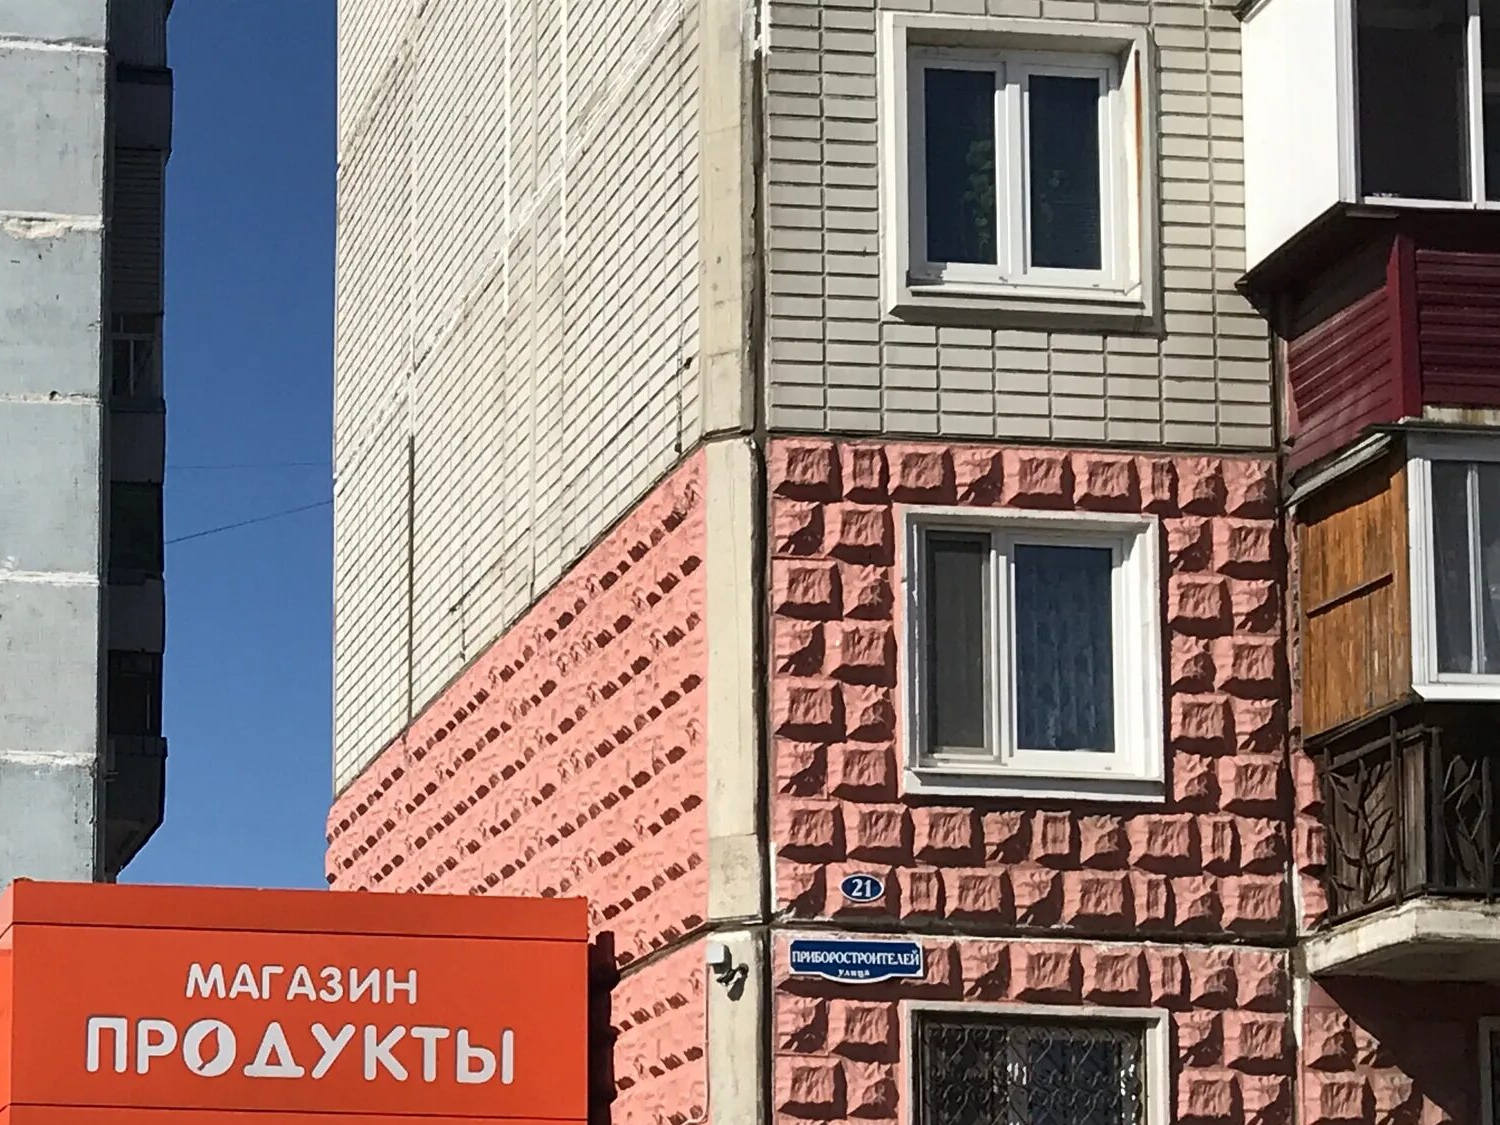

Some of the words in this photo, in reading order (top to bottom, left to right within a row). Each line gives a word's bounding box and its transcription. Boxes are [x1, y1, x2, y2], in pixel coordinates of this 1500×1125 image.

[852, 879, 872, 897] 21
[792, 950, 919, 966] ПРИБОРОСТРОИТЕЛЕЙ
[185, 962, 417, 1004] МАГАЗИН
[85, 1016, 514, 1084] ПРОДУКТЫ
